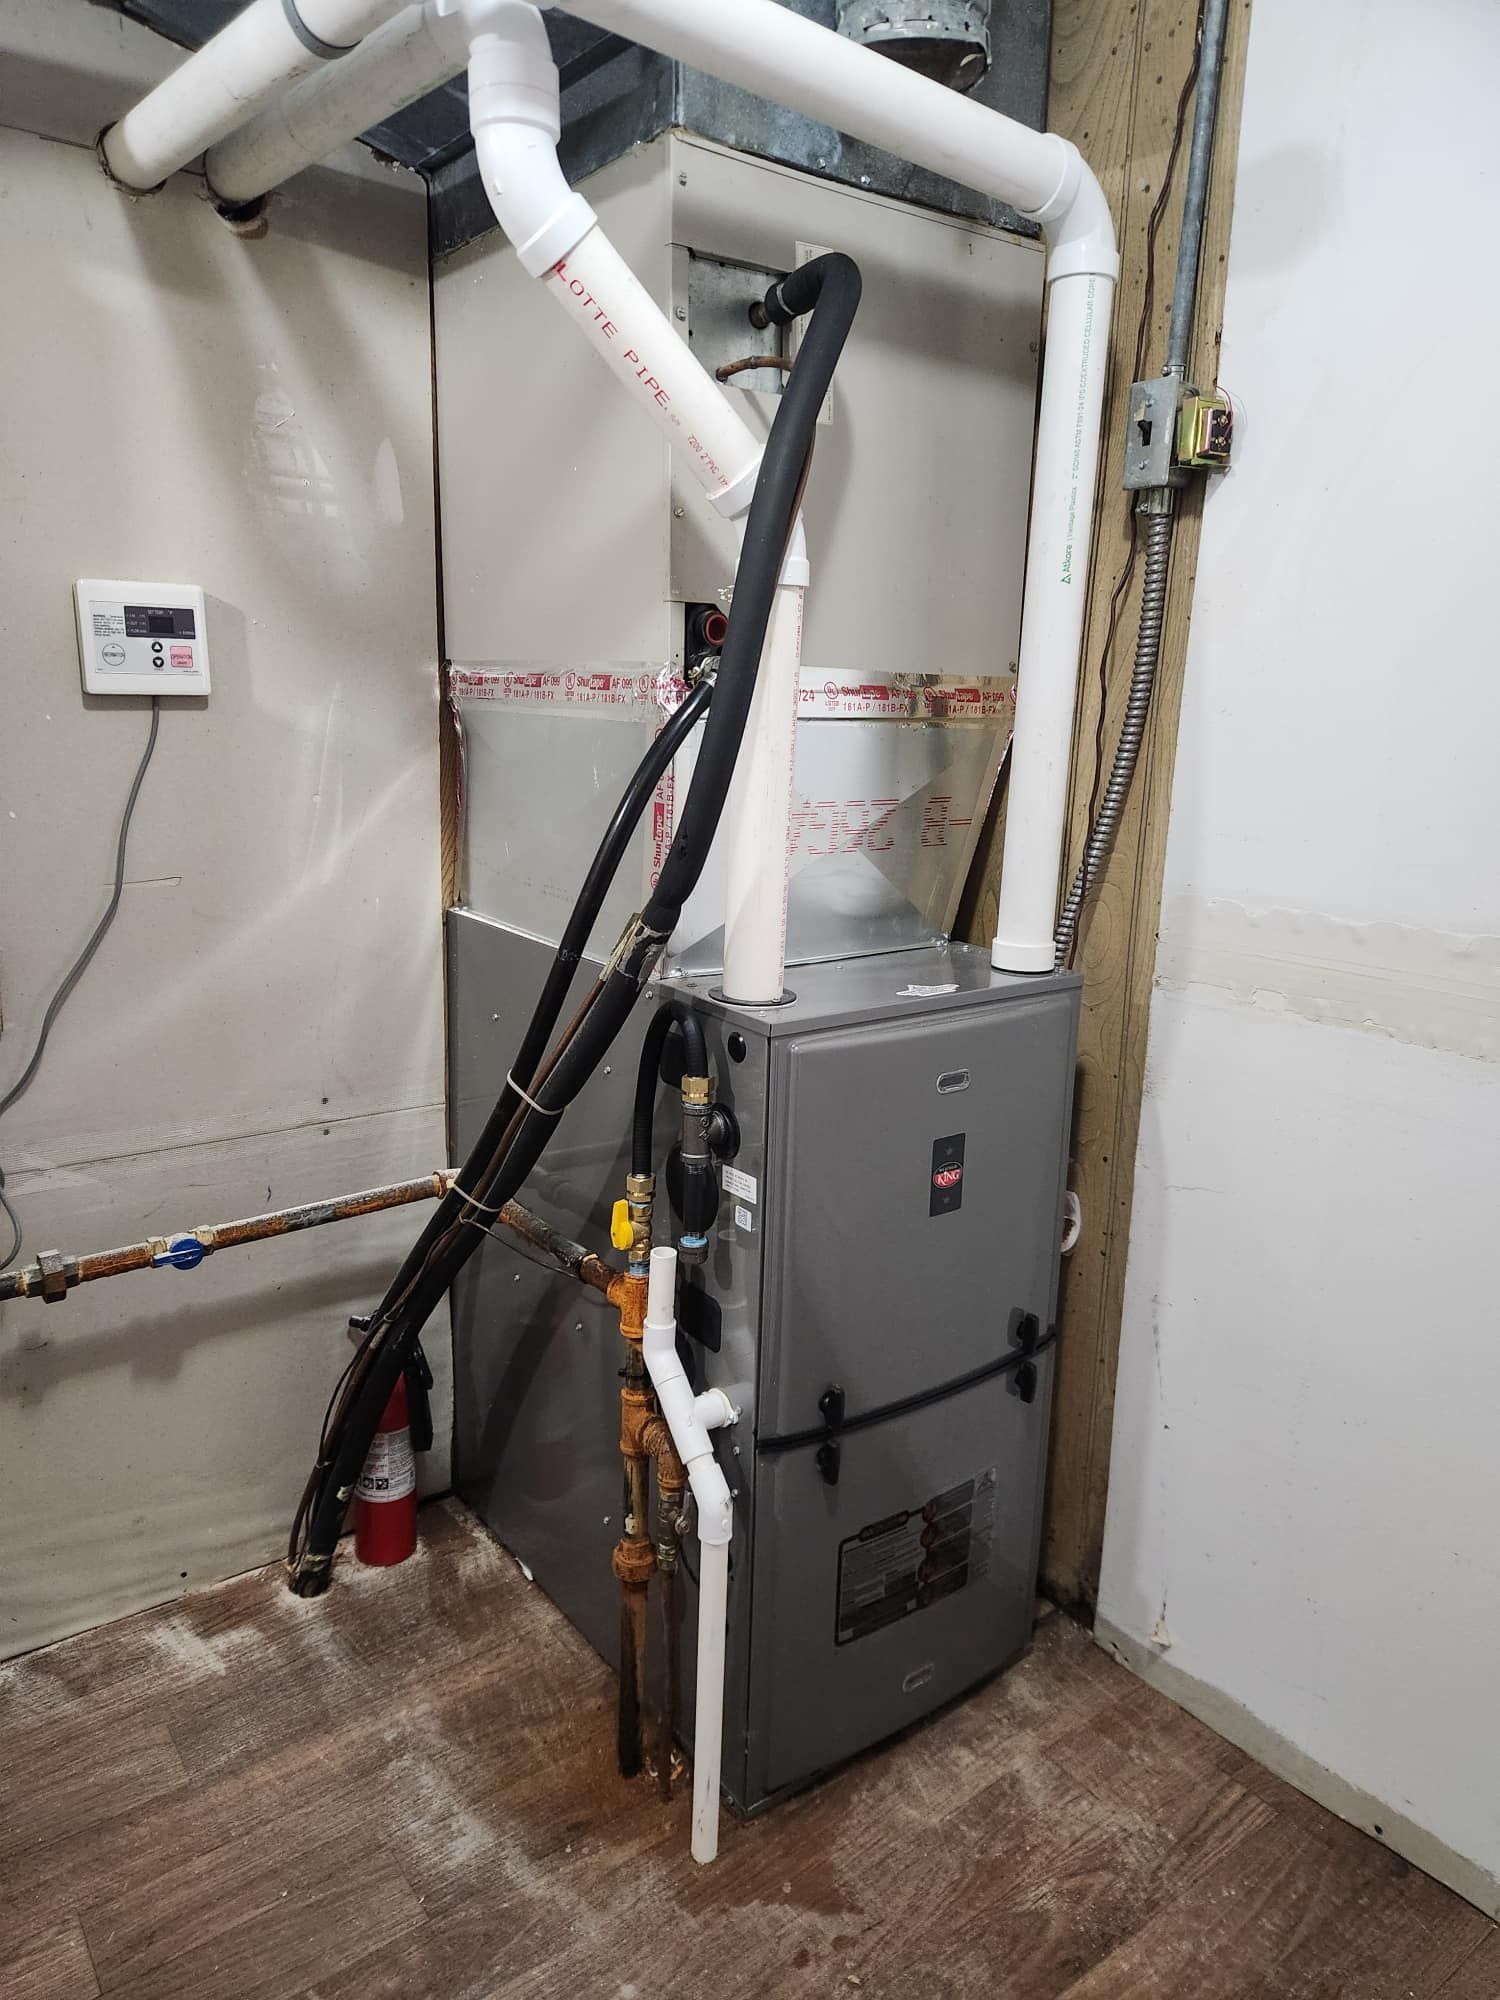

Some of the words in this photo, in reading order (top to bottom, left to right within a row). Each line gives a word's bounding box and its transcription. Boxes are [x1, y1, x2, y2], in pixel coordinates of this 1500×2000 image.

[554, 260, 618, 340] LOTTE
[1063, 544, 1072, 572] Atkore
[576, 676, 606, 690] Shurtape
[611, 678, 621, 690] AF
[622, 678, 632, 690] 099
[576, 693, 596, 702] 181A-P
[600, 694, 626, 704] 181B-FX
[841, 686, 882, 700] Shurtape
[843, 702, 871, 713] 181A-P
[878, 703, 910, 714] 181B-FX
[653, 814, 664, 868] Shurtape
[936, 1168, 961, 1186] KING
